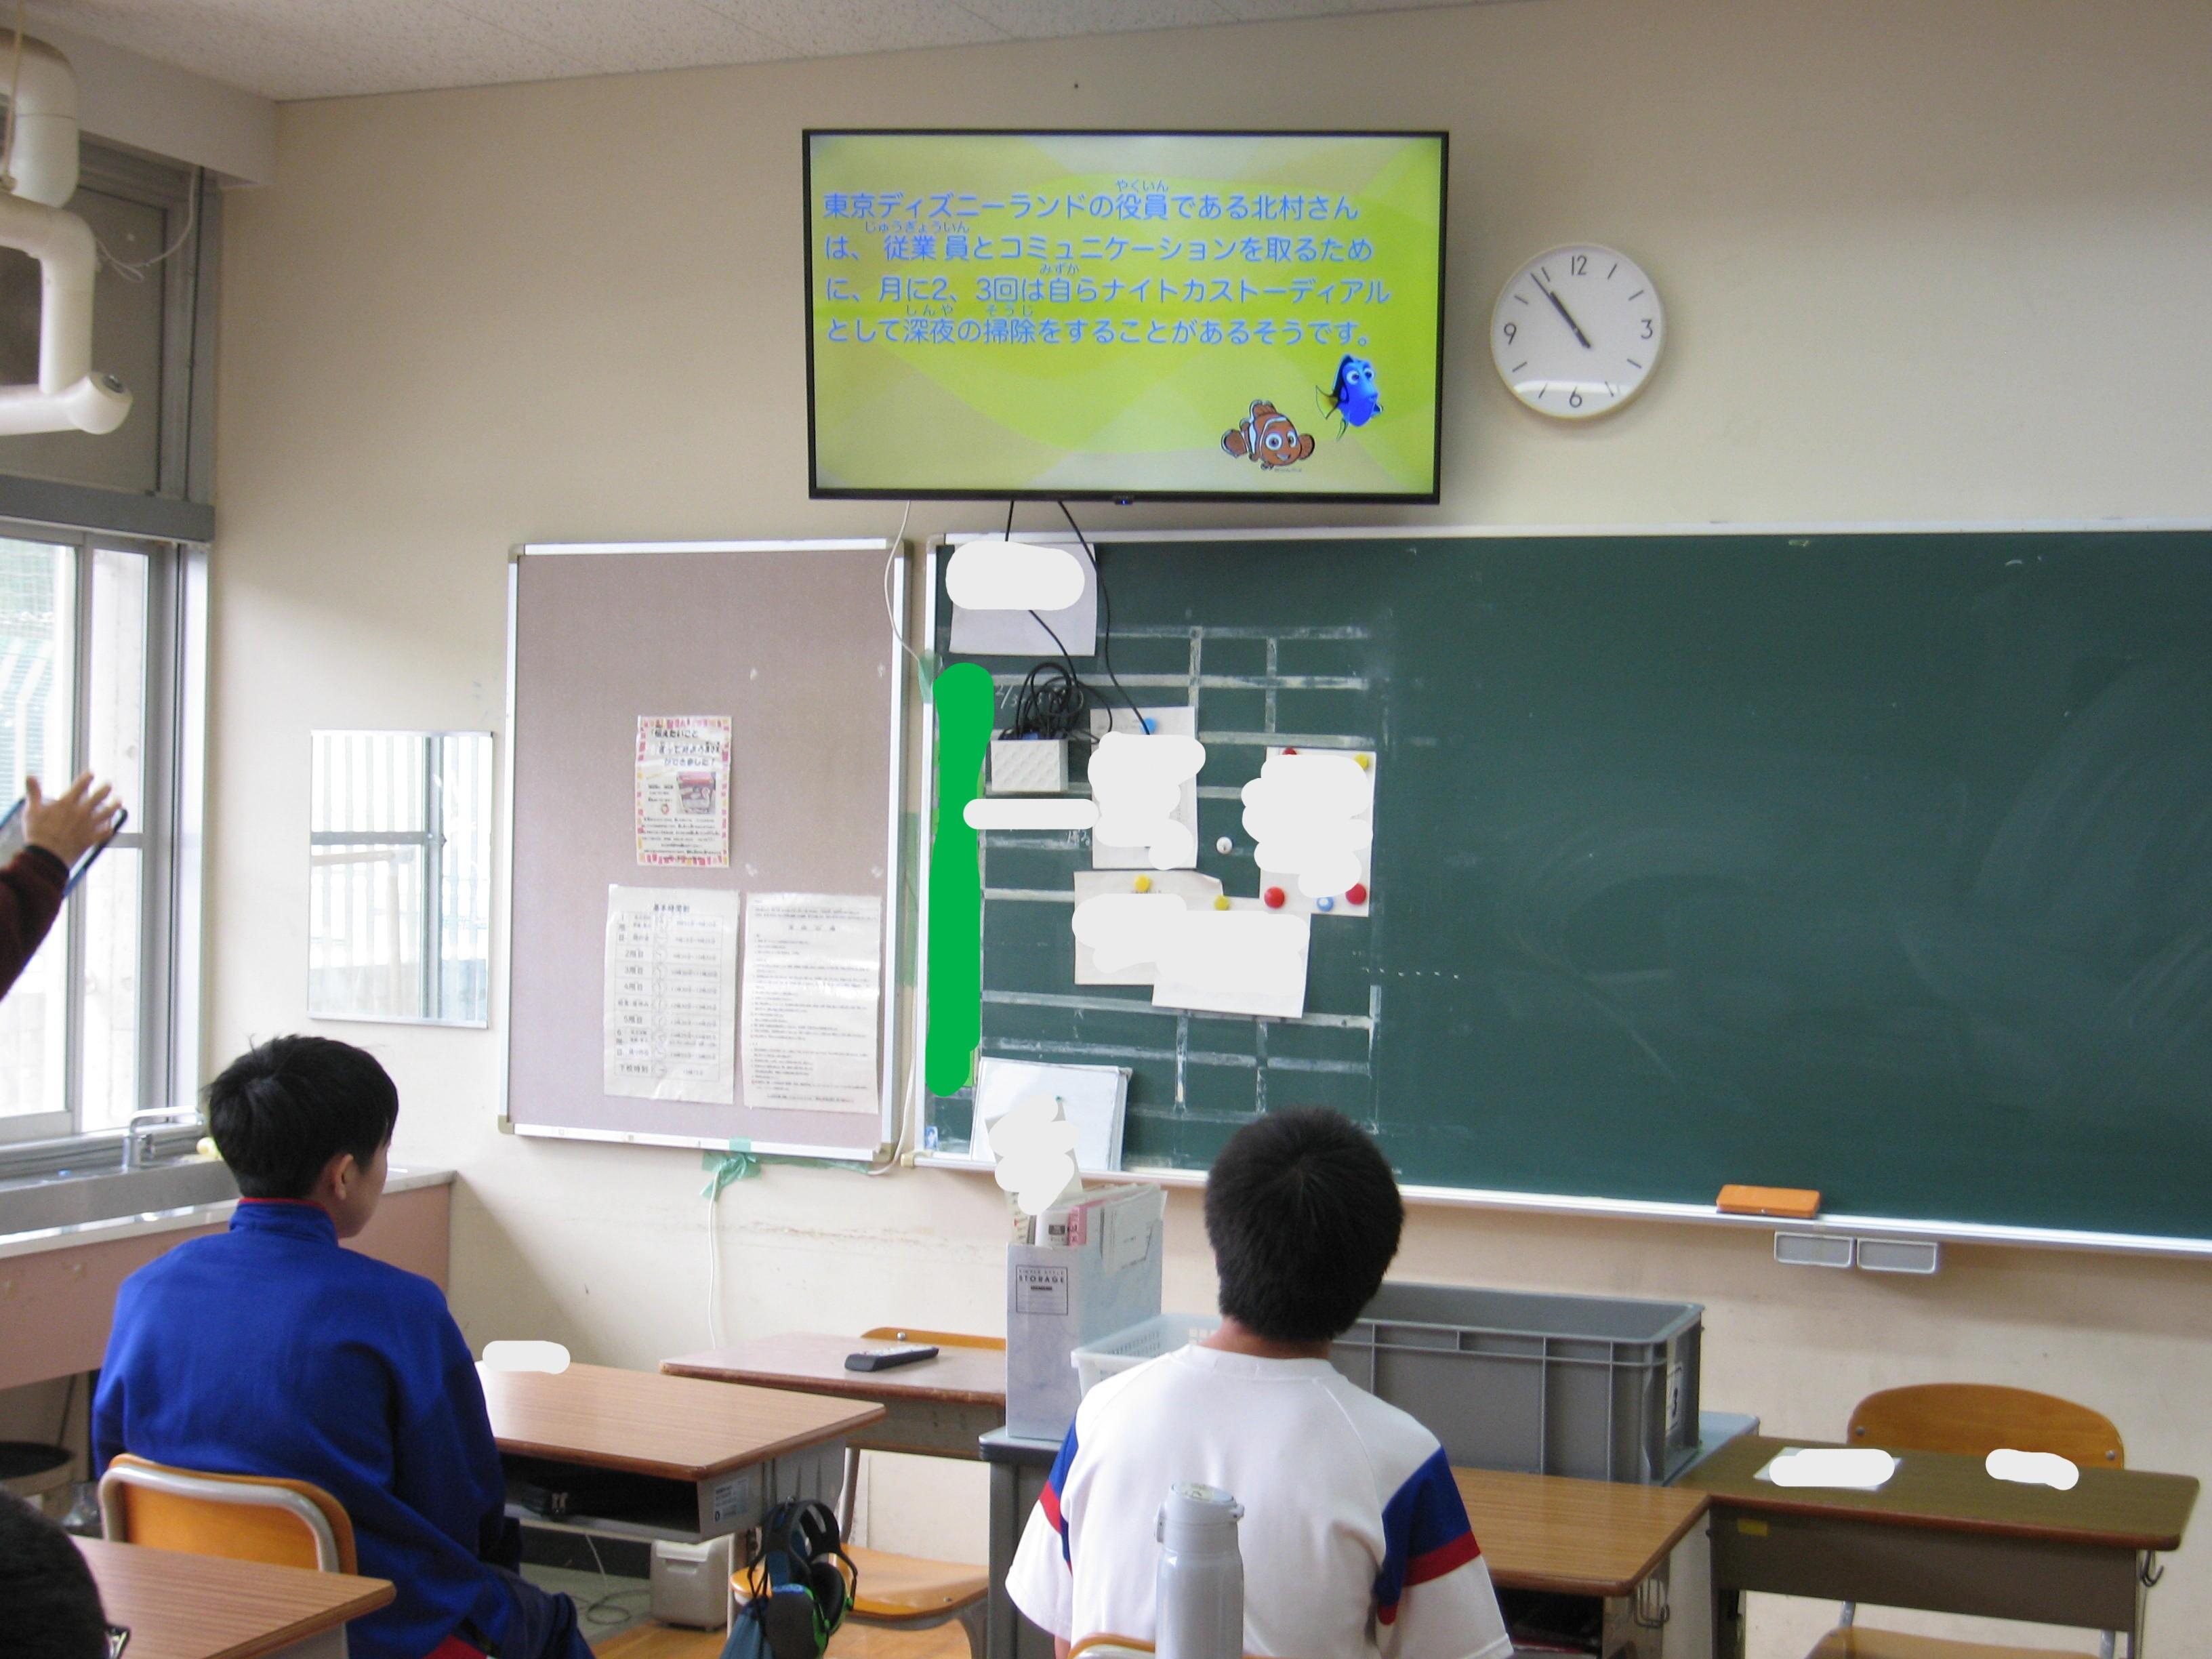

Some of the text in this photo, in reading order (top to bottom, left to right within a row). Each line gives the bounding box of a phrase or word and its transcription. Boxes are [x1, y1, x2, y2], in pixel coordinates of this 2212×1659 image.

[1117, 180, 1169, 191] やくいん
[823, 192, 1359, 220] 東京ディズニーランドの役員である北村さん
[1571, 255, 1587, 276] 12
[907, 304, 954, 316] しんや
[986, 304, 1033, 316] そうじ
[827, 319, 1368, 346] として深夜の掃除をすることがあるそうです。
[1503, 323, 1517, 345] 9
[1641, 319, 1654, 339] 3
[1569, 386, 1582, 407] 6
[1019, 1275, 1064, 1284] STORAGE
